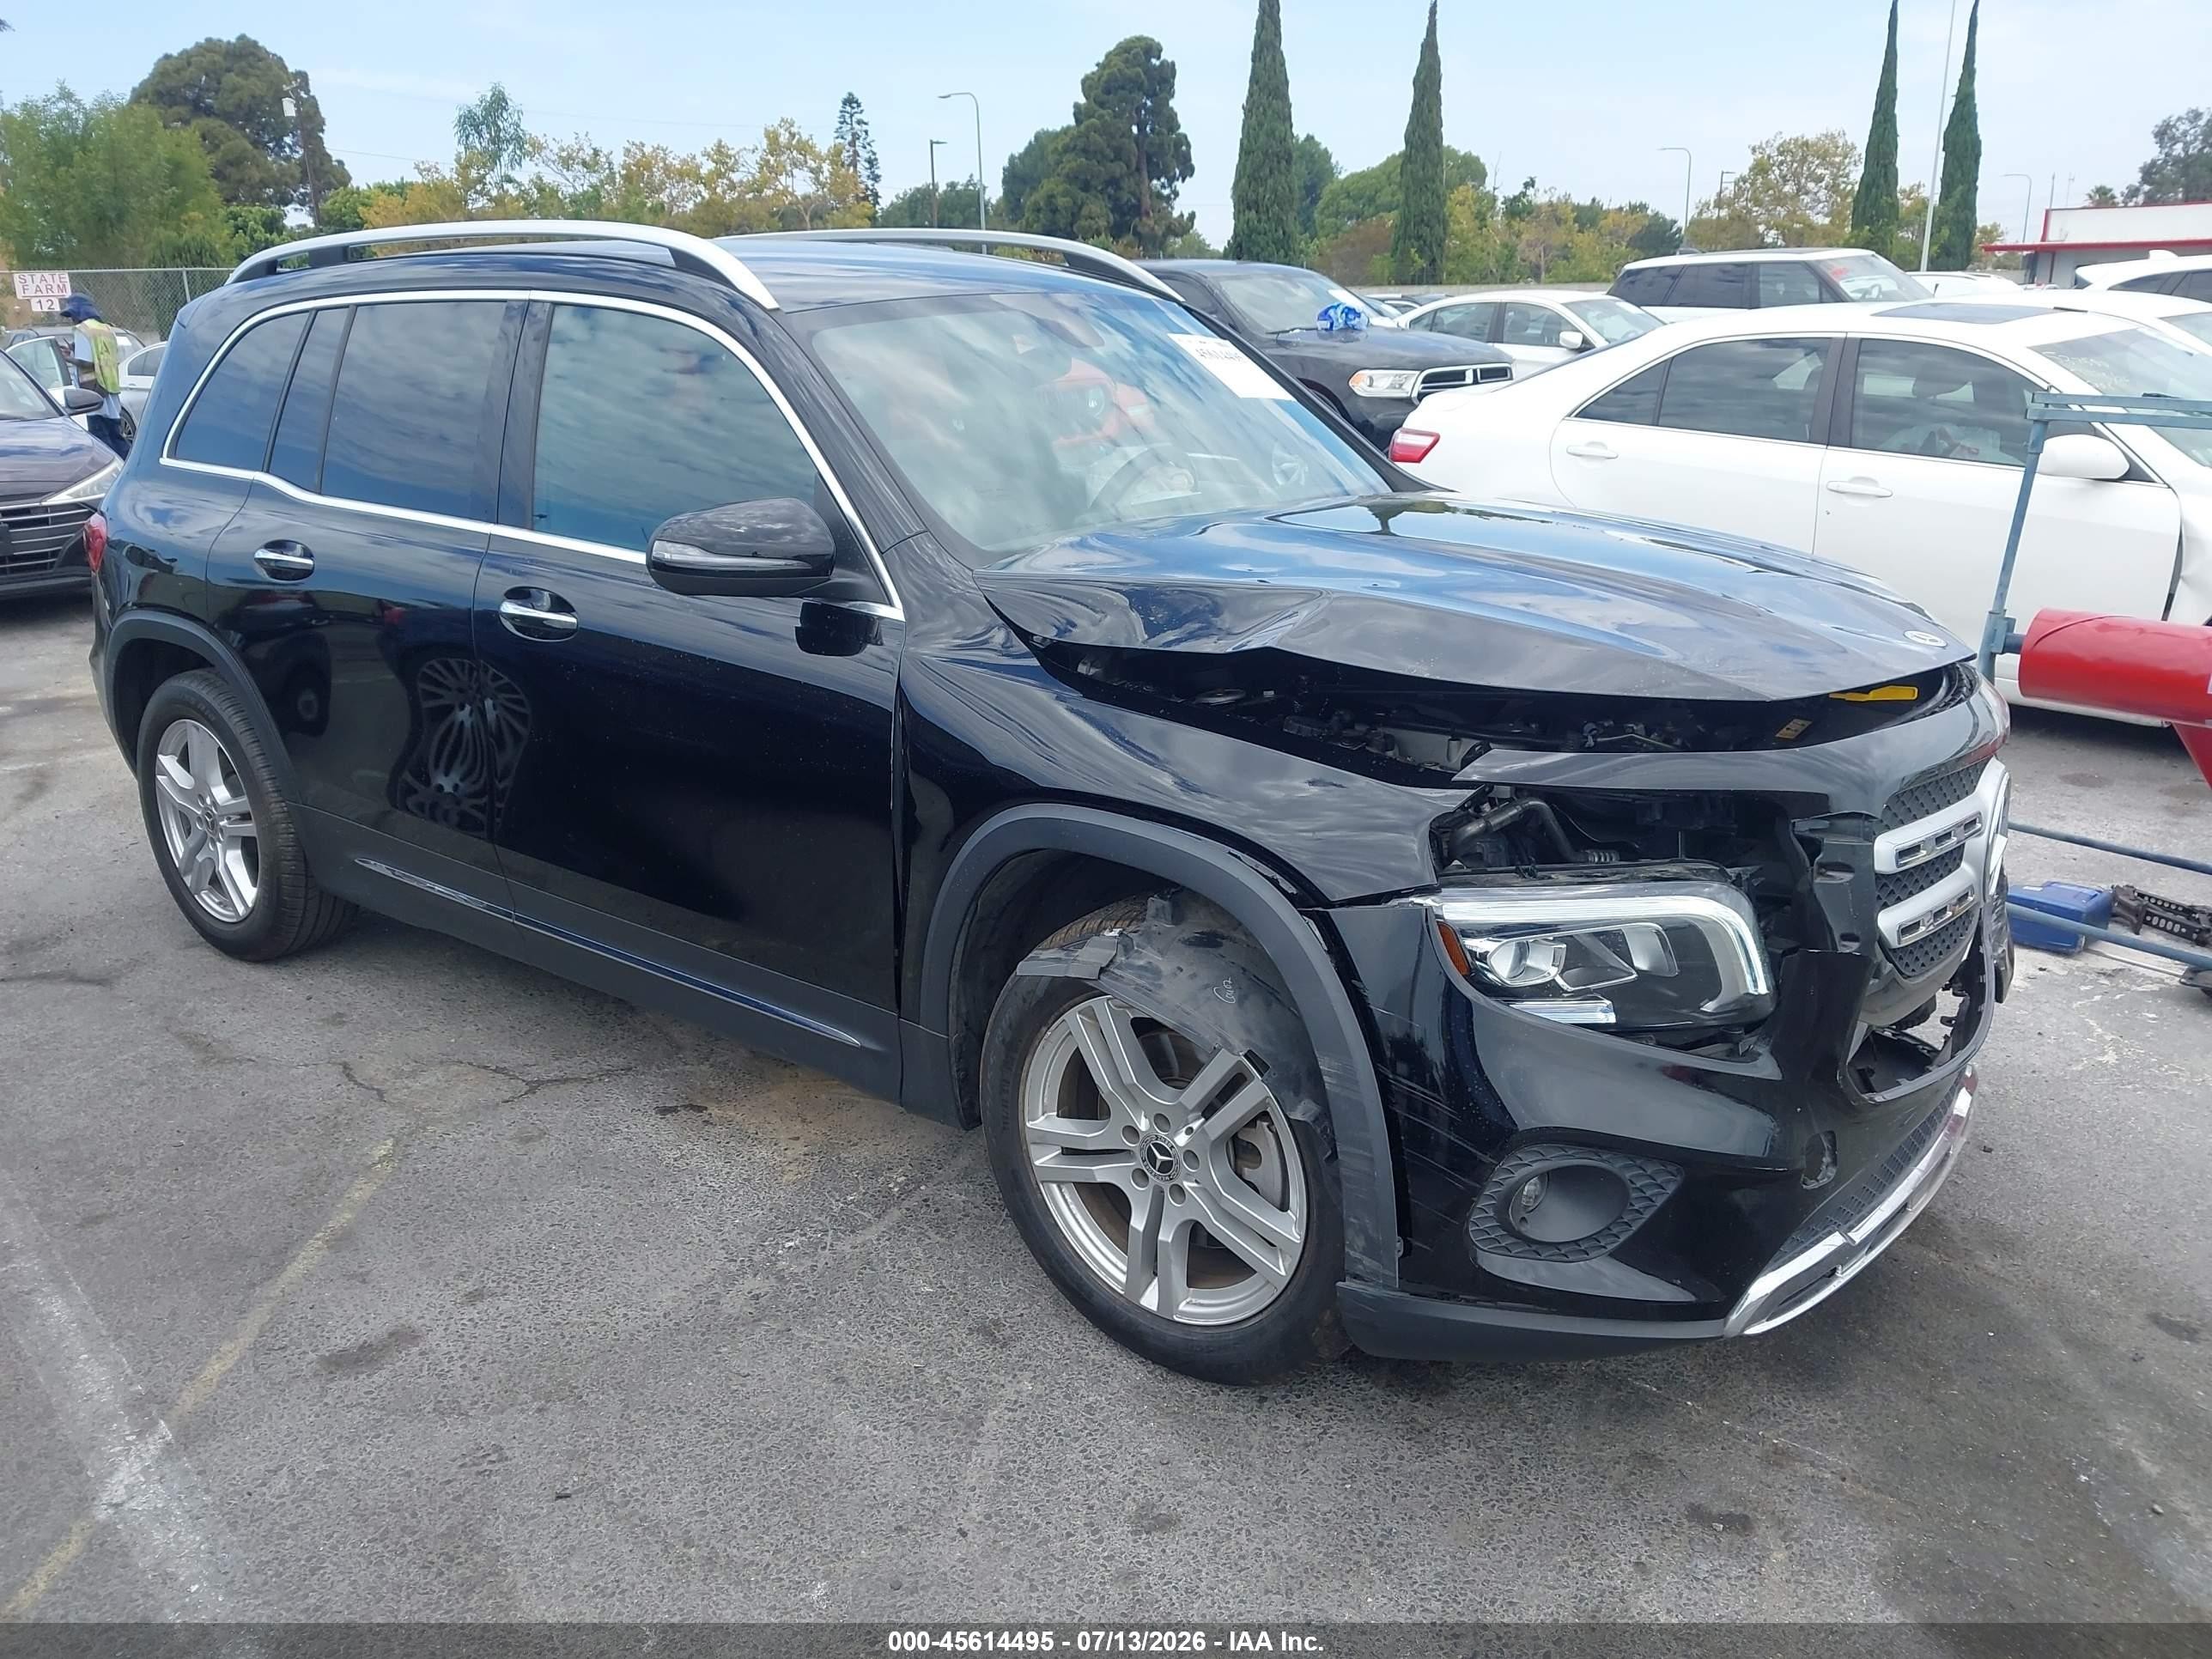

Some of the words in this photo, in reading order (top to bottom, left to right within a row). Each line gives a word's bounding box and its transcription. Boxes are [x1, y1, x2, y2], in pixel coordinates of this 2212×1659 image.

[18, 273, 68, 284] STATE
[22, 283, 68, 295] FARM
[37, 299, 55, 310] 12
